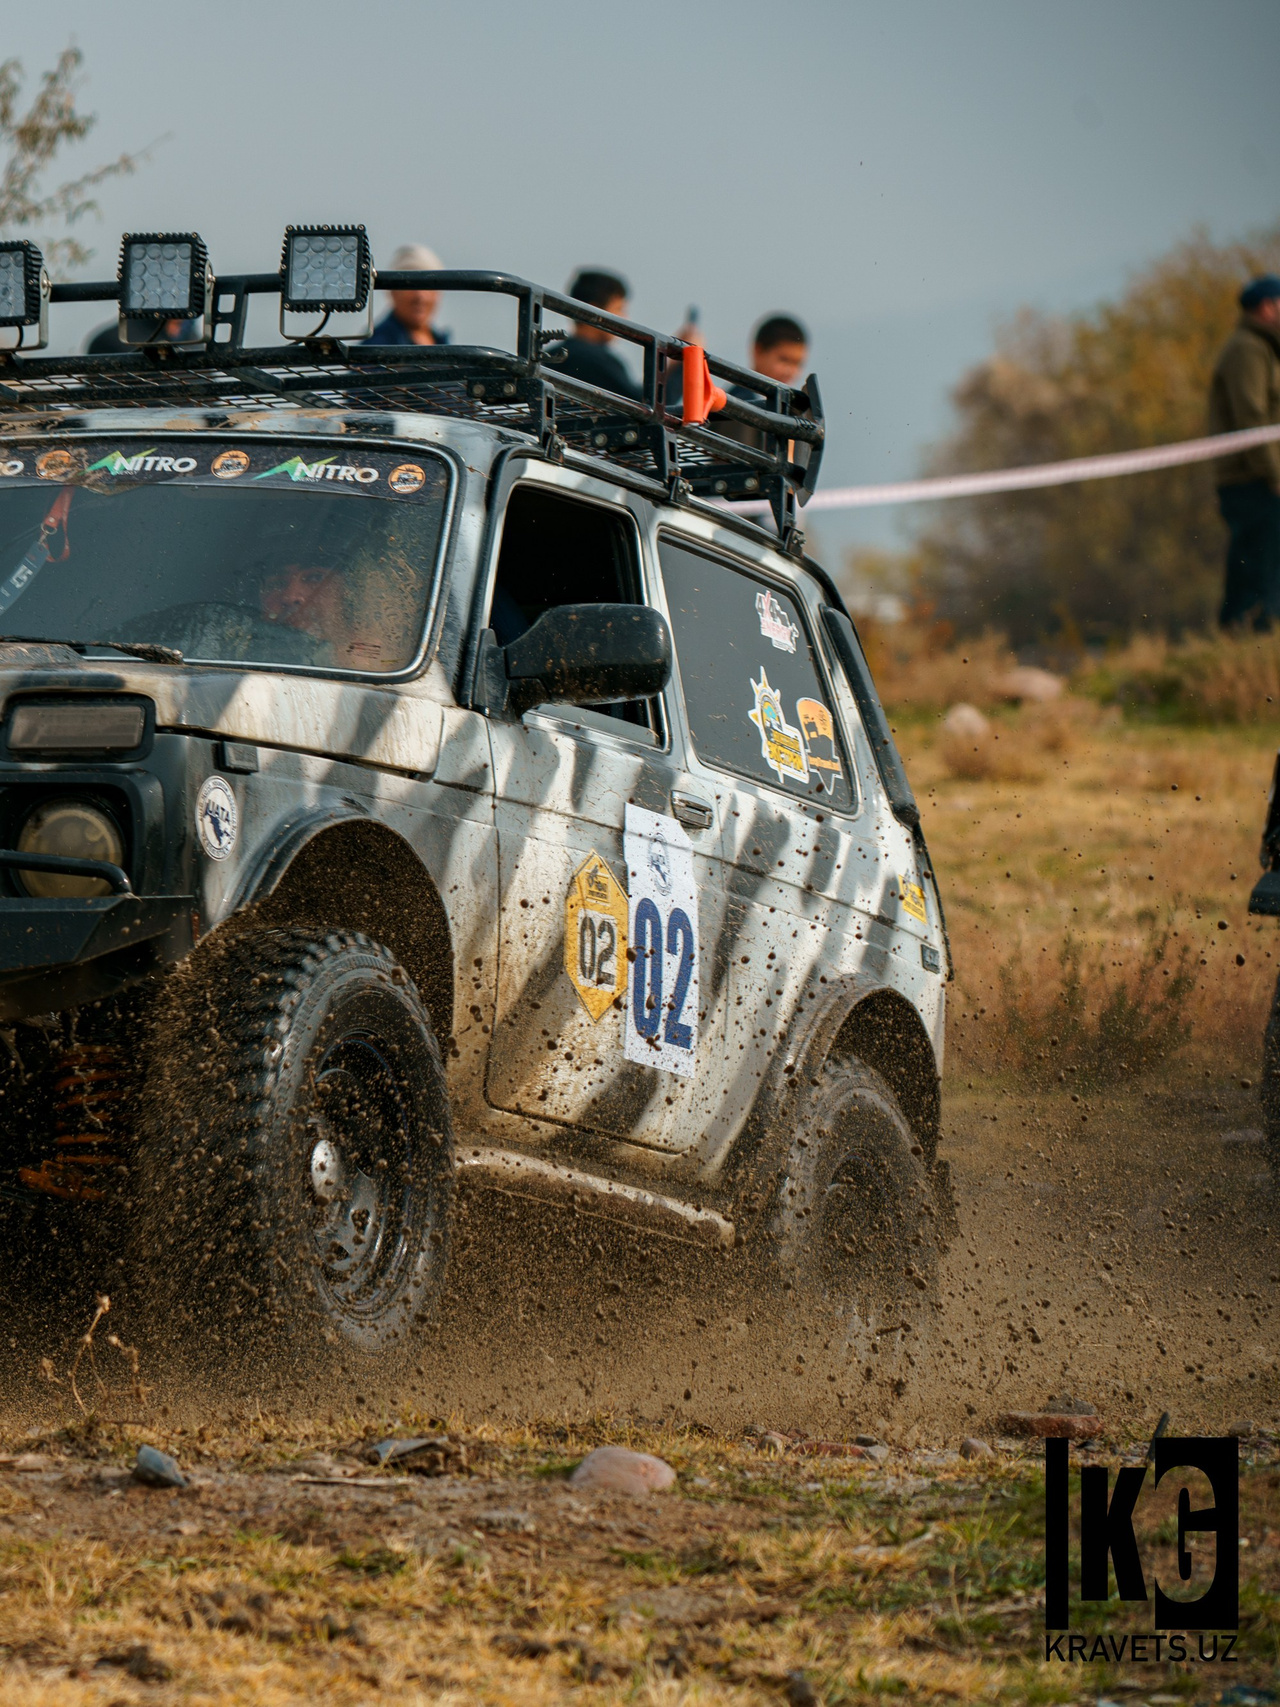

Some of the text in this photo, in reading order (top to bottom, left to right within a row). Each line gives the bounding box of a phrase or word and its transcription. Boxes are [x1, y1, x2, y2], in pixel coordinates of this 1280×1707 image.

[113, 456, 198, 473] NITRO
[293, 463, 380, 483] NITRO
[207, 799, 230, 823] UATA
[579, 916, 616, 986] 02
[633, 897, 694, 1050] 02
